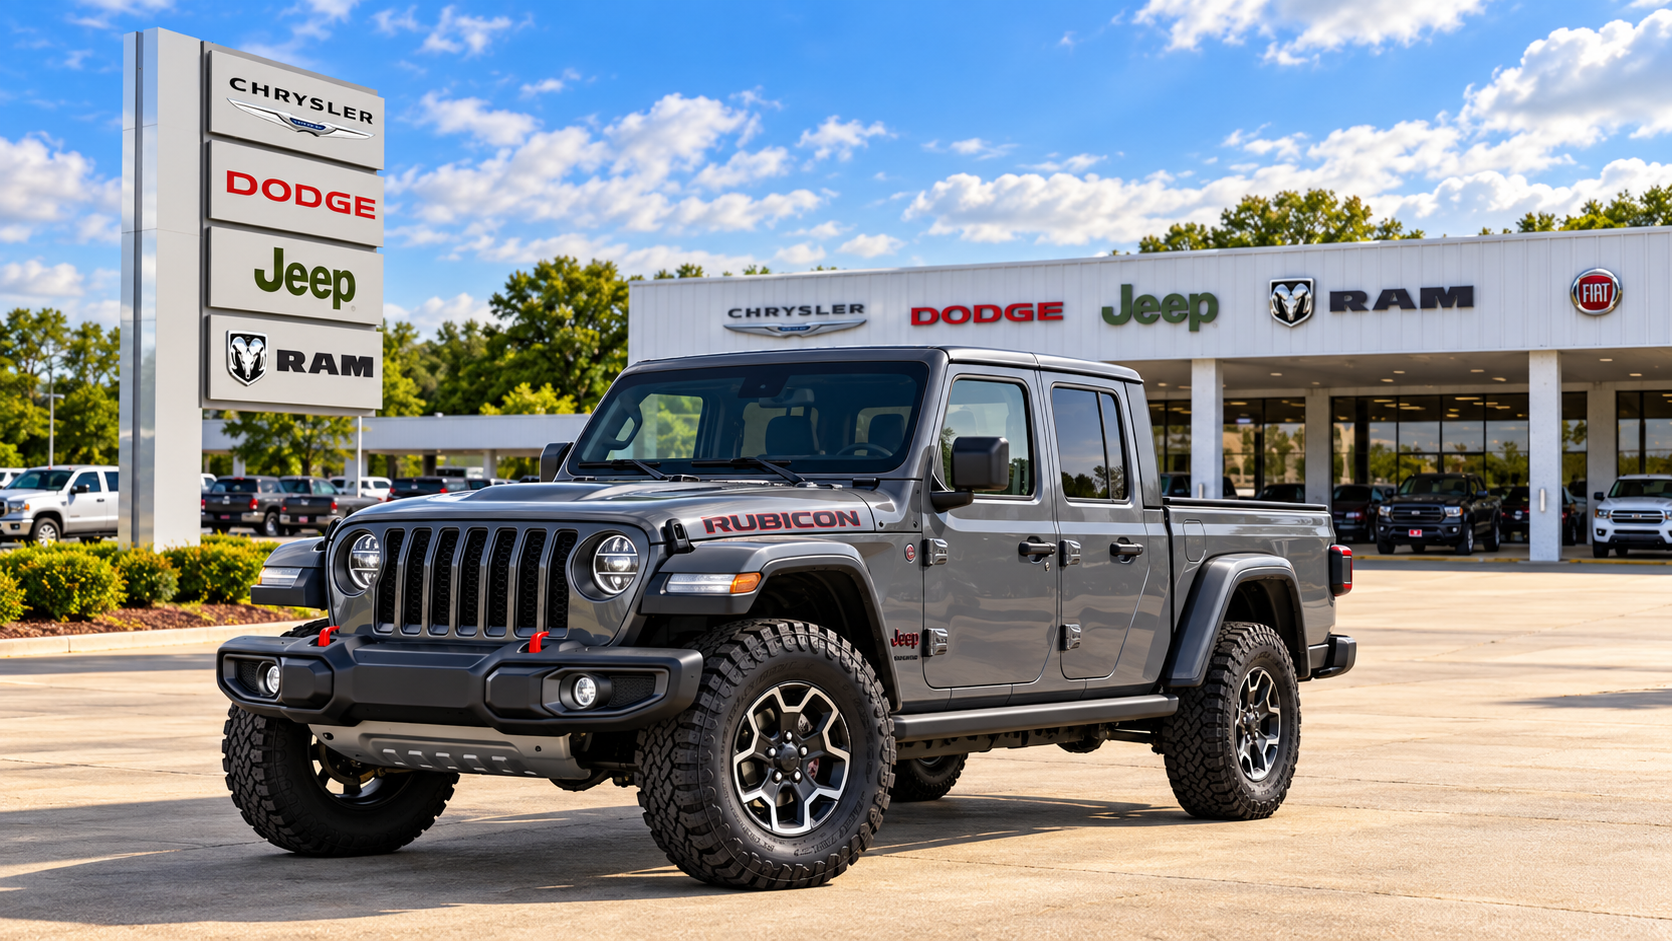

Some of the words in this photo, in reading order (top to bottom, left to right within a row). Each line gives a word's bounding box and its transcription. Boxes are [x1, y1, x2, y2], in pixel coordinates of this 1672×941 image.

[229, 77, 373, 124] CHRYSLER
[226, 170, 376, 219] DODGE
[254, 247, 356, 310] Jeep
[1329, 285, 1474, 312] RAM
[1582, 282, 1610, 303] FIAT
[727, 303, 865, 318] CHRYSLER
[911, 301, 1064, 326] DODGE
[1101, 284, 1219, 332] Jeep
[276, 348, 374, 378] RAM
[701, 510, 861, 535] RUBICON
[890, 628, 919, 649] Jeep
